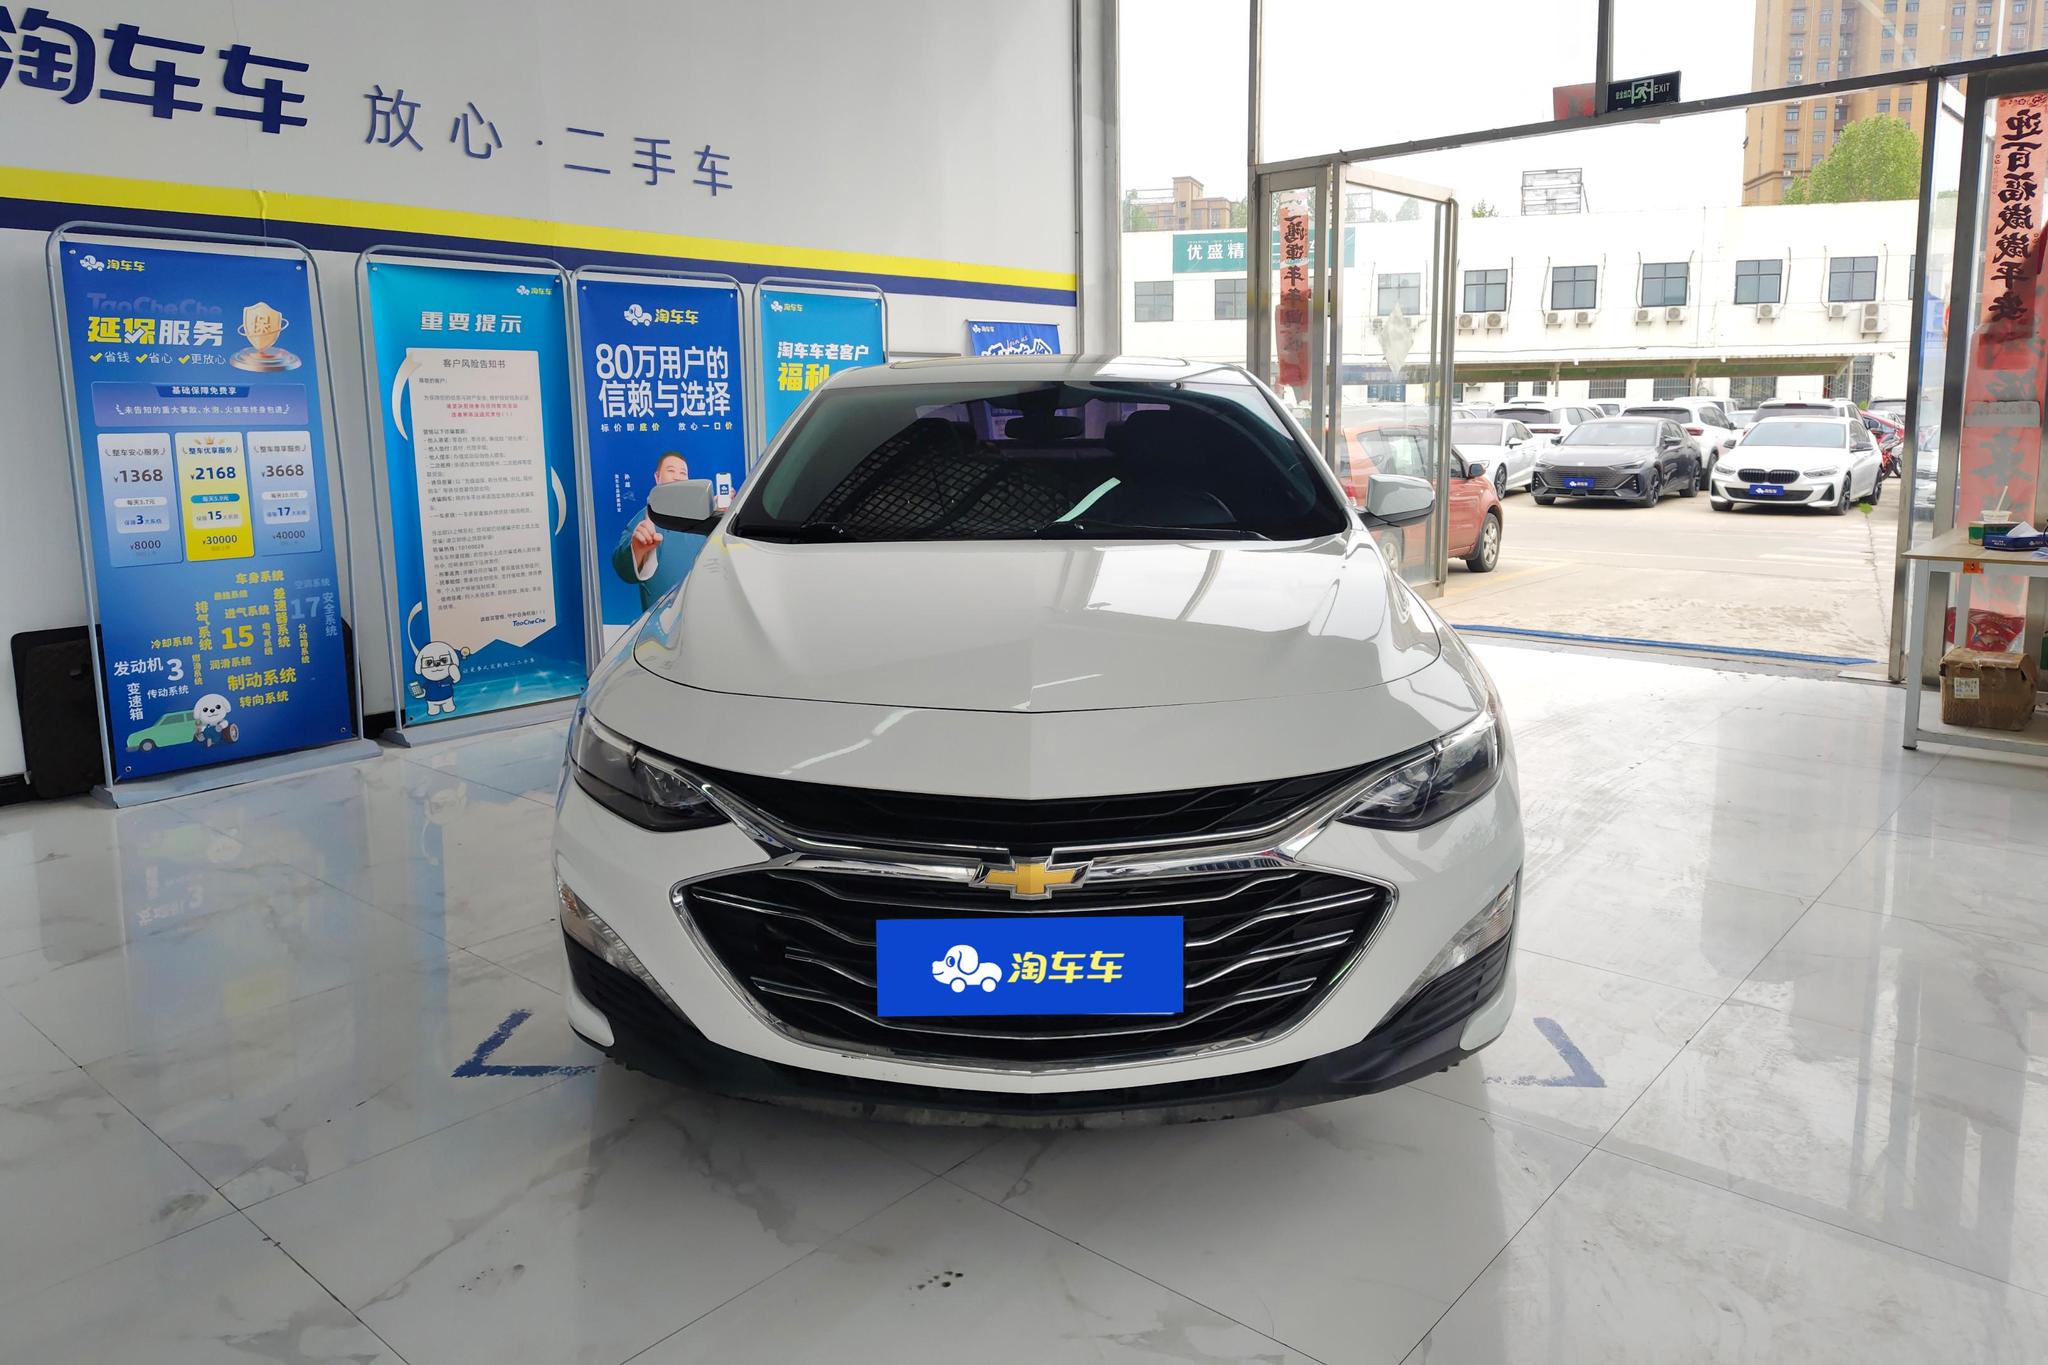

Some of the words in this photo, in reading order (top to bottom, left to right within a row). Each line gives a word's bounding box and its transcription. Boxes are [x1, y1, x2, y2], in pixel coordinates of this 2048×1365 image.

[0, 7, 309, 133] 淘车车
[1654, 83, 1670, 93] EXIT
[107, 259, 145, 272] 淘车车
[421, 311, 522, 333] 重要提示
[655, 309, 698, 324] 淘车车
[87, 316, 224, 346] 延保服务
[104, 351, 130, 363] 省钱
[150, 353, 172, 364] 省心
[191, 354, 226, 365] 更放心
[777, 342, 869, 361] 淘车车老客户
[443, 358, 506, 369] 客户风险告知书
[596, 344, 728, 379] 80万用户的
[778, 363, 829, 391] 福利
[172, 386, 237, 396] 基础保障免费享
[599, 380, 731, 418] 信赖与选择
[601, 423, 660, 432] 标价即底价
[678, 422, 733, 431] 放心一口价
[113, 468, 164, 483] ¥1368
[190, 466, 236, 480] ¥2168
[261, 464, 304, 478] ¥3668
[130, 540, 161, 550] ¥8000
[202, 535, 238, 545] ¥30000
[235, 570, 285, 585] 车身系统
[291, 597, 320, 619] 17
[322, 592, 338, 637] 安全系统
[151, 636, 193, 650] 冷却系统
[221, 625, 255, 650] 15
[113, 658, 163, 677] 发动机
[167, 658, 184, 681] 3
[227, 668, 297, 692] 制动系统
[147, 685, 190, 700] 传动系统
[239, 691, 289, 708] 转向系统
[127, 683, 144, 721] 变速箱
